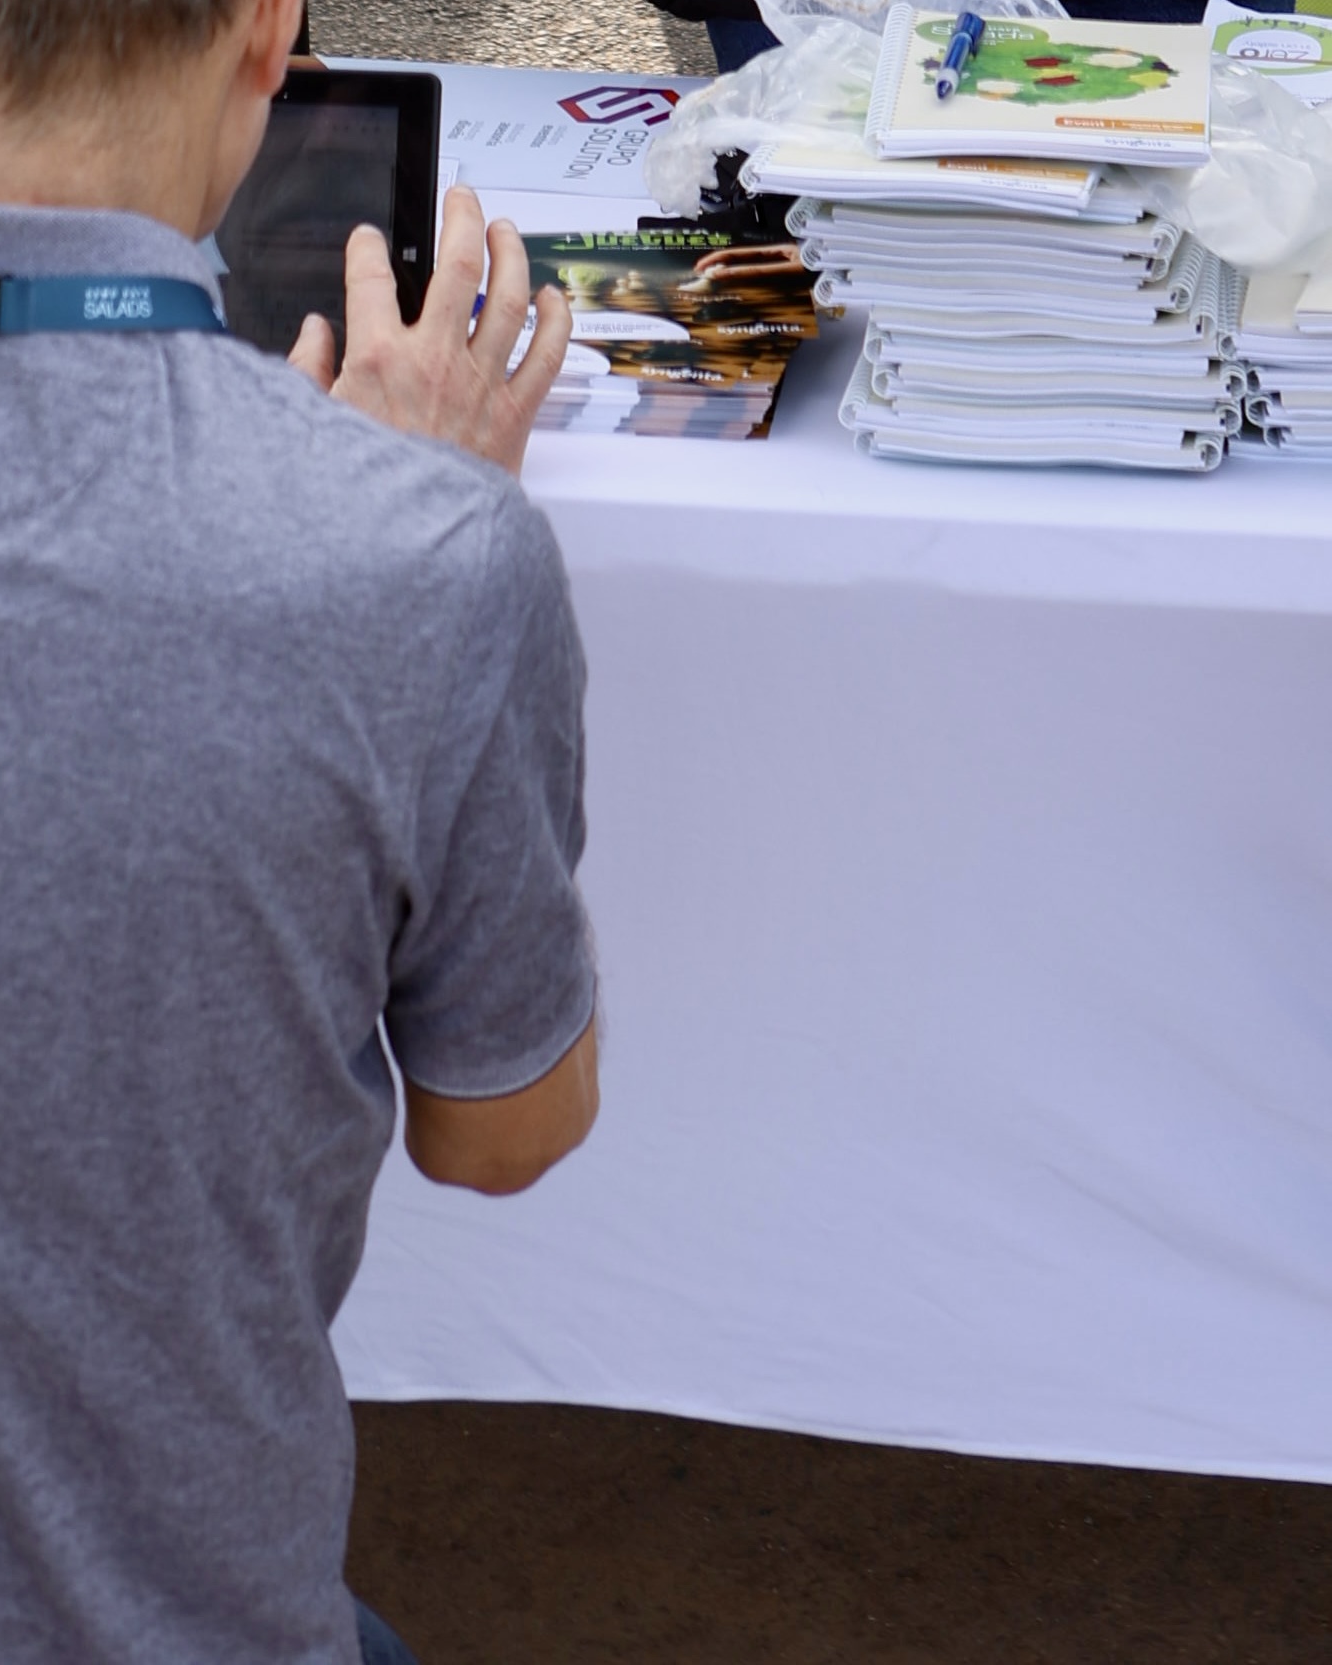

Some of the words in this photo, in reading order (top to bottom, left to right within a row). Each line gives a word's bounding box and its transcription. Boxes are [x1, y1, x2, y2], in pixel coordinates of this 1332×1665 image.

[563, 127, 617, 180] SOLUTION
[607, 129, 649, 166] GRUPO
[84, 299, 153, 320] SALADS
